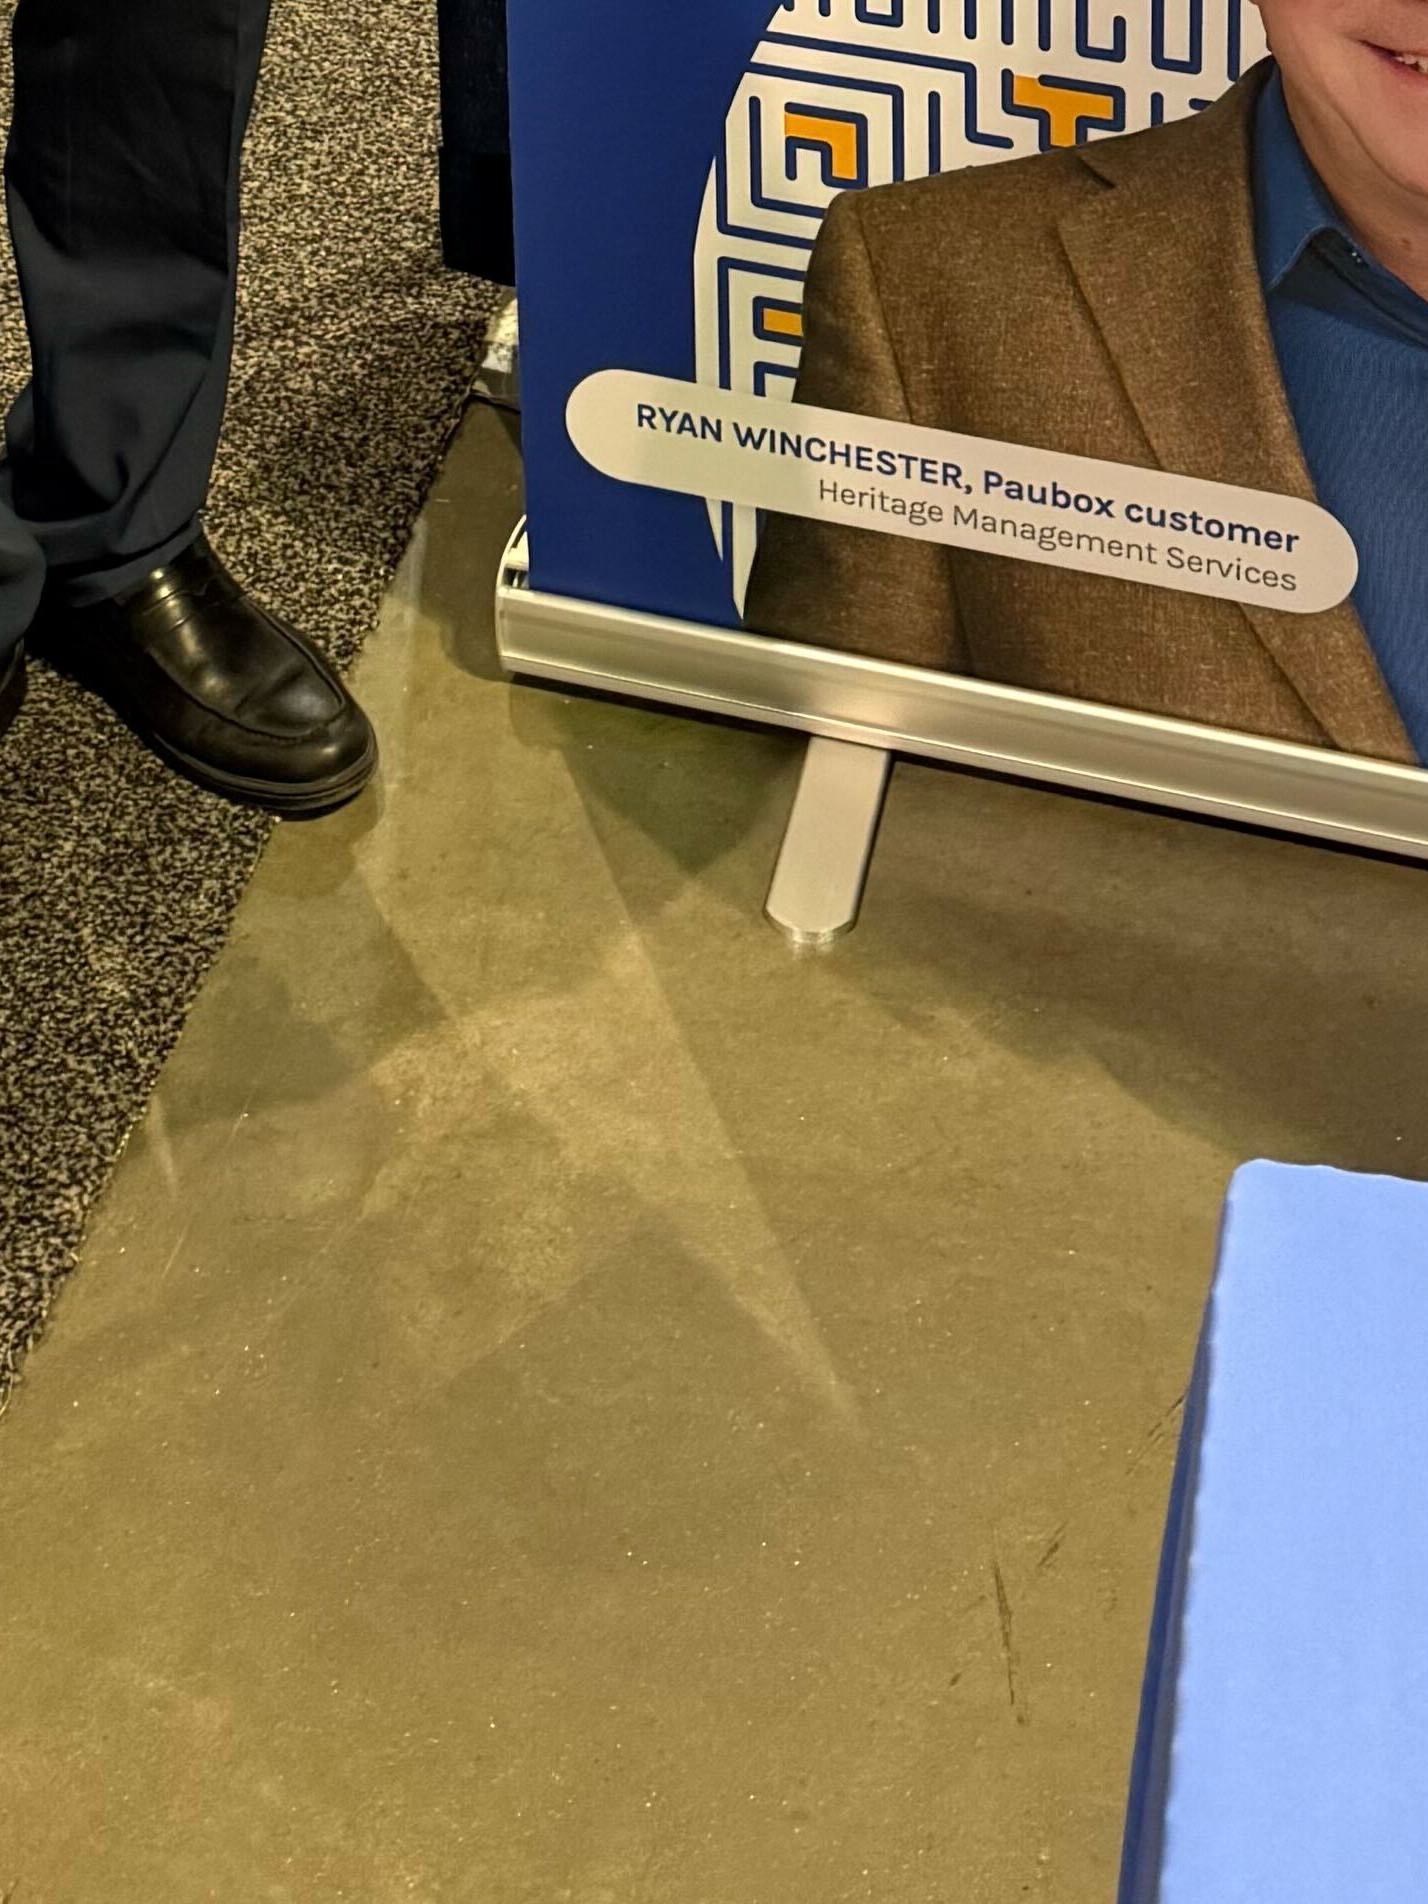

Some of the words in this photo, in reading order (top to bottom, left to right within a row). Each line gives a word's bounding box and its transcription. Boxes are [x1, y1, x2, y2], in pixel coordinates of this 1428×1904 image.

[636, 403, 723, 443] RYAN
[732, 422, 972, 495] WINCHESTER,
[982, 470, 1115, 520] Paubox
[1124, 503, 1300, 555] customer
[818, 478, 944, 526] Heritage
[953, 505, 1158, 567] Management
[1166, 545, 1297, 592] Services
